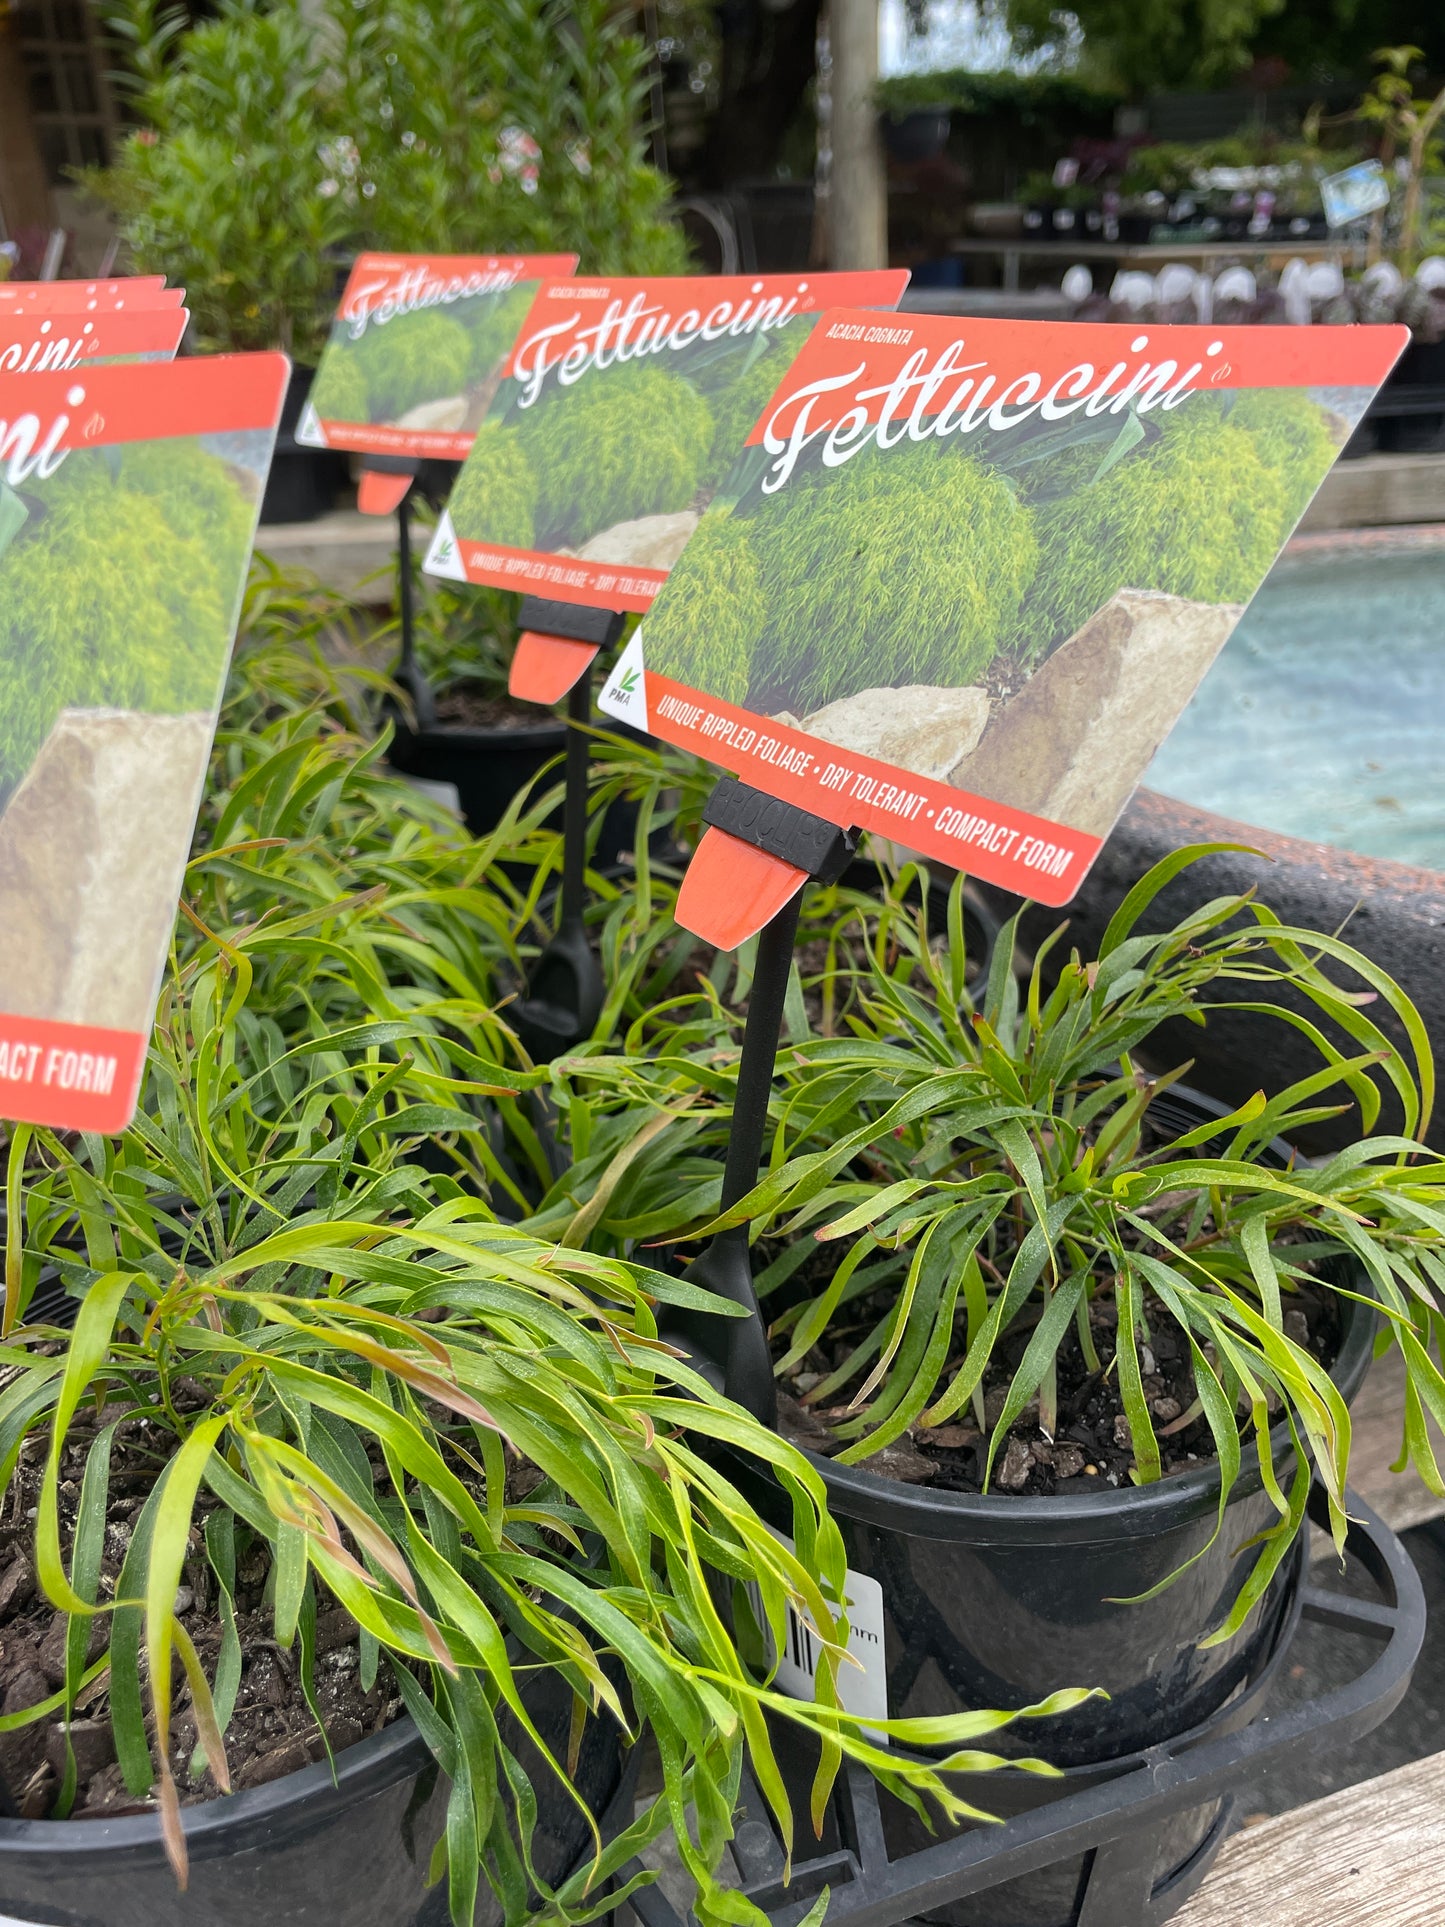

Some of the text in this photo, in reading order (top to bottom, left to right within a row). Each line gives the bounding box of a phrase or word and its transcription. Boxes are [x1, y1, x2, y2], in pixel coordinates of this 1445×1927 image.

[513, 281, 809, 409] Fettuccini
[825, 323, 914, 346] ACACIA COGNATA
[761, 335, 1224, 495] Fettuccini
[469, 552, 505, 573] UNIQUE
[504, 556, 546, 580] RIPPLED
[548, 565, 590, 589] FOLIAGE
[593, 575, 617, 593] DRY
[608, 688, 631, 707] PMA
[656, 694, 1075, 879] UNIQUE RIPPLED FOLIAGE DRY TOLERANT COMPACT FORM
[43, 1047, 118, 1097] FORM
